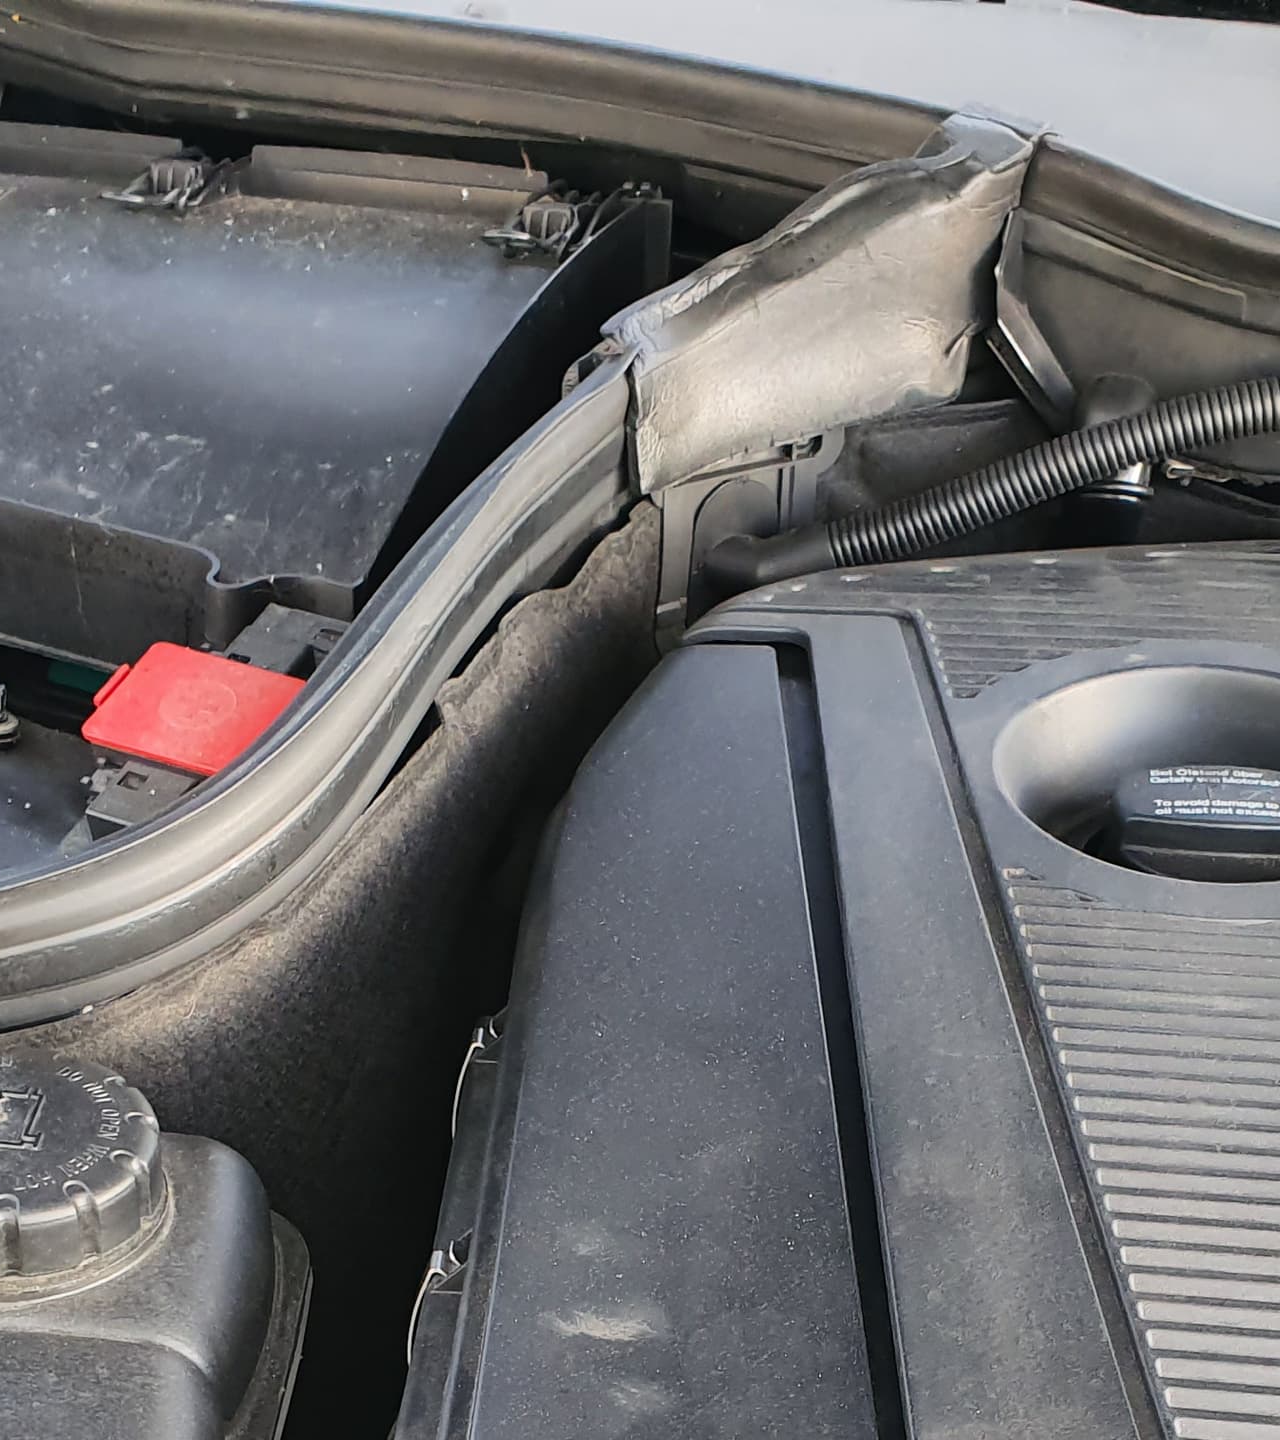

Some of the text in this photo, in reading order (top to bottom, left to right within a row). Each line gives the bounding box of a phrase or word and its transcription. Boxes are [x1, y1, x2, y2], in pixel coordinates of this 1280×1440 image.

[1153, 799, 1172, 807] To
[1173, 799, 1210, 808] avoid
[1211, 800, 1264, 810] damage
[1265, 802, 1280, 810] to
[1154, 807, 1173, 815] oil
[1210, 807, 1233, 816] not
[57, 1066, 84, 1082] DO
[81, 1081, 116, 1104] NOT
[97, 1108, 120, 1141] OPEN
